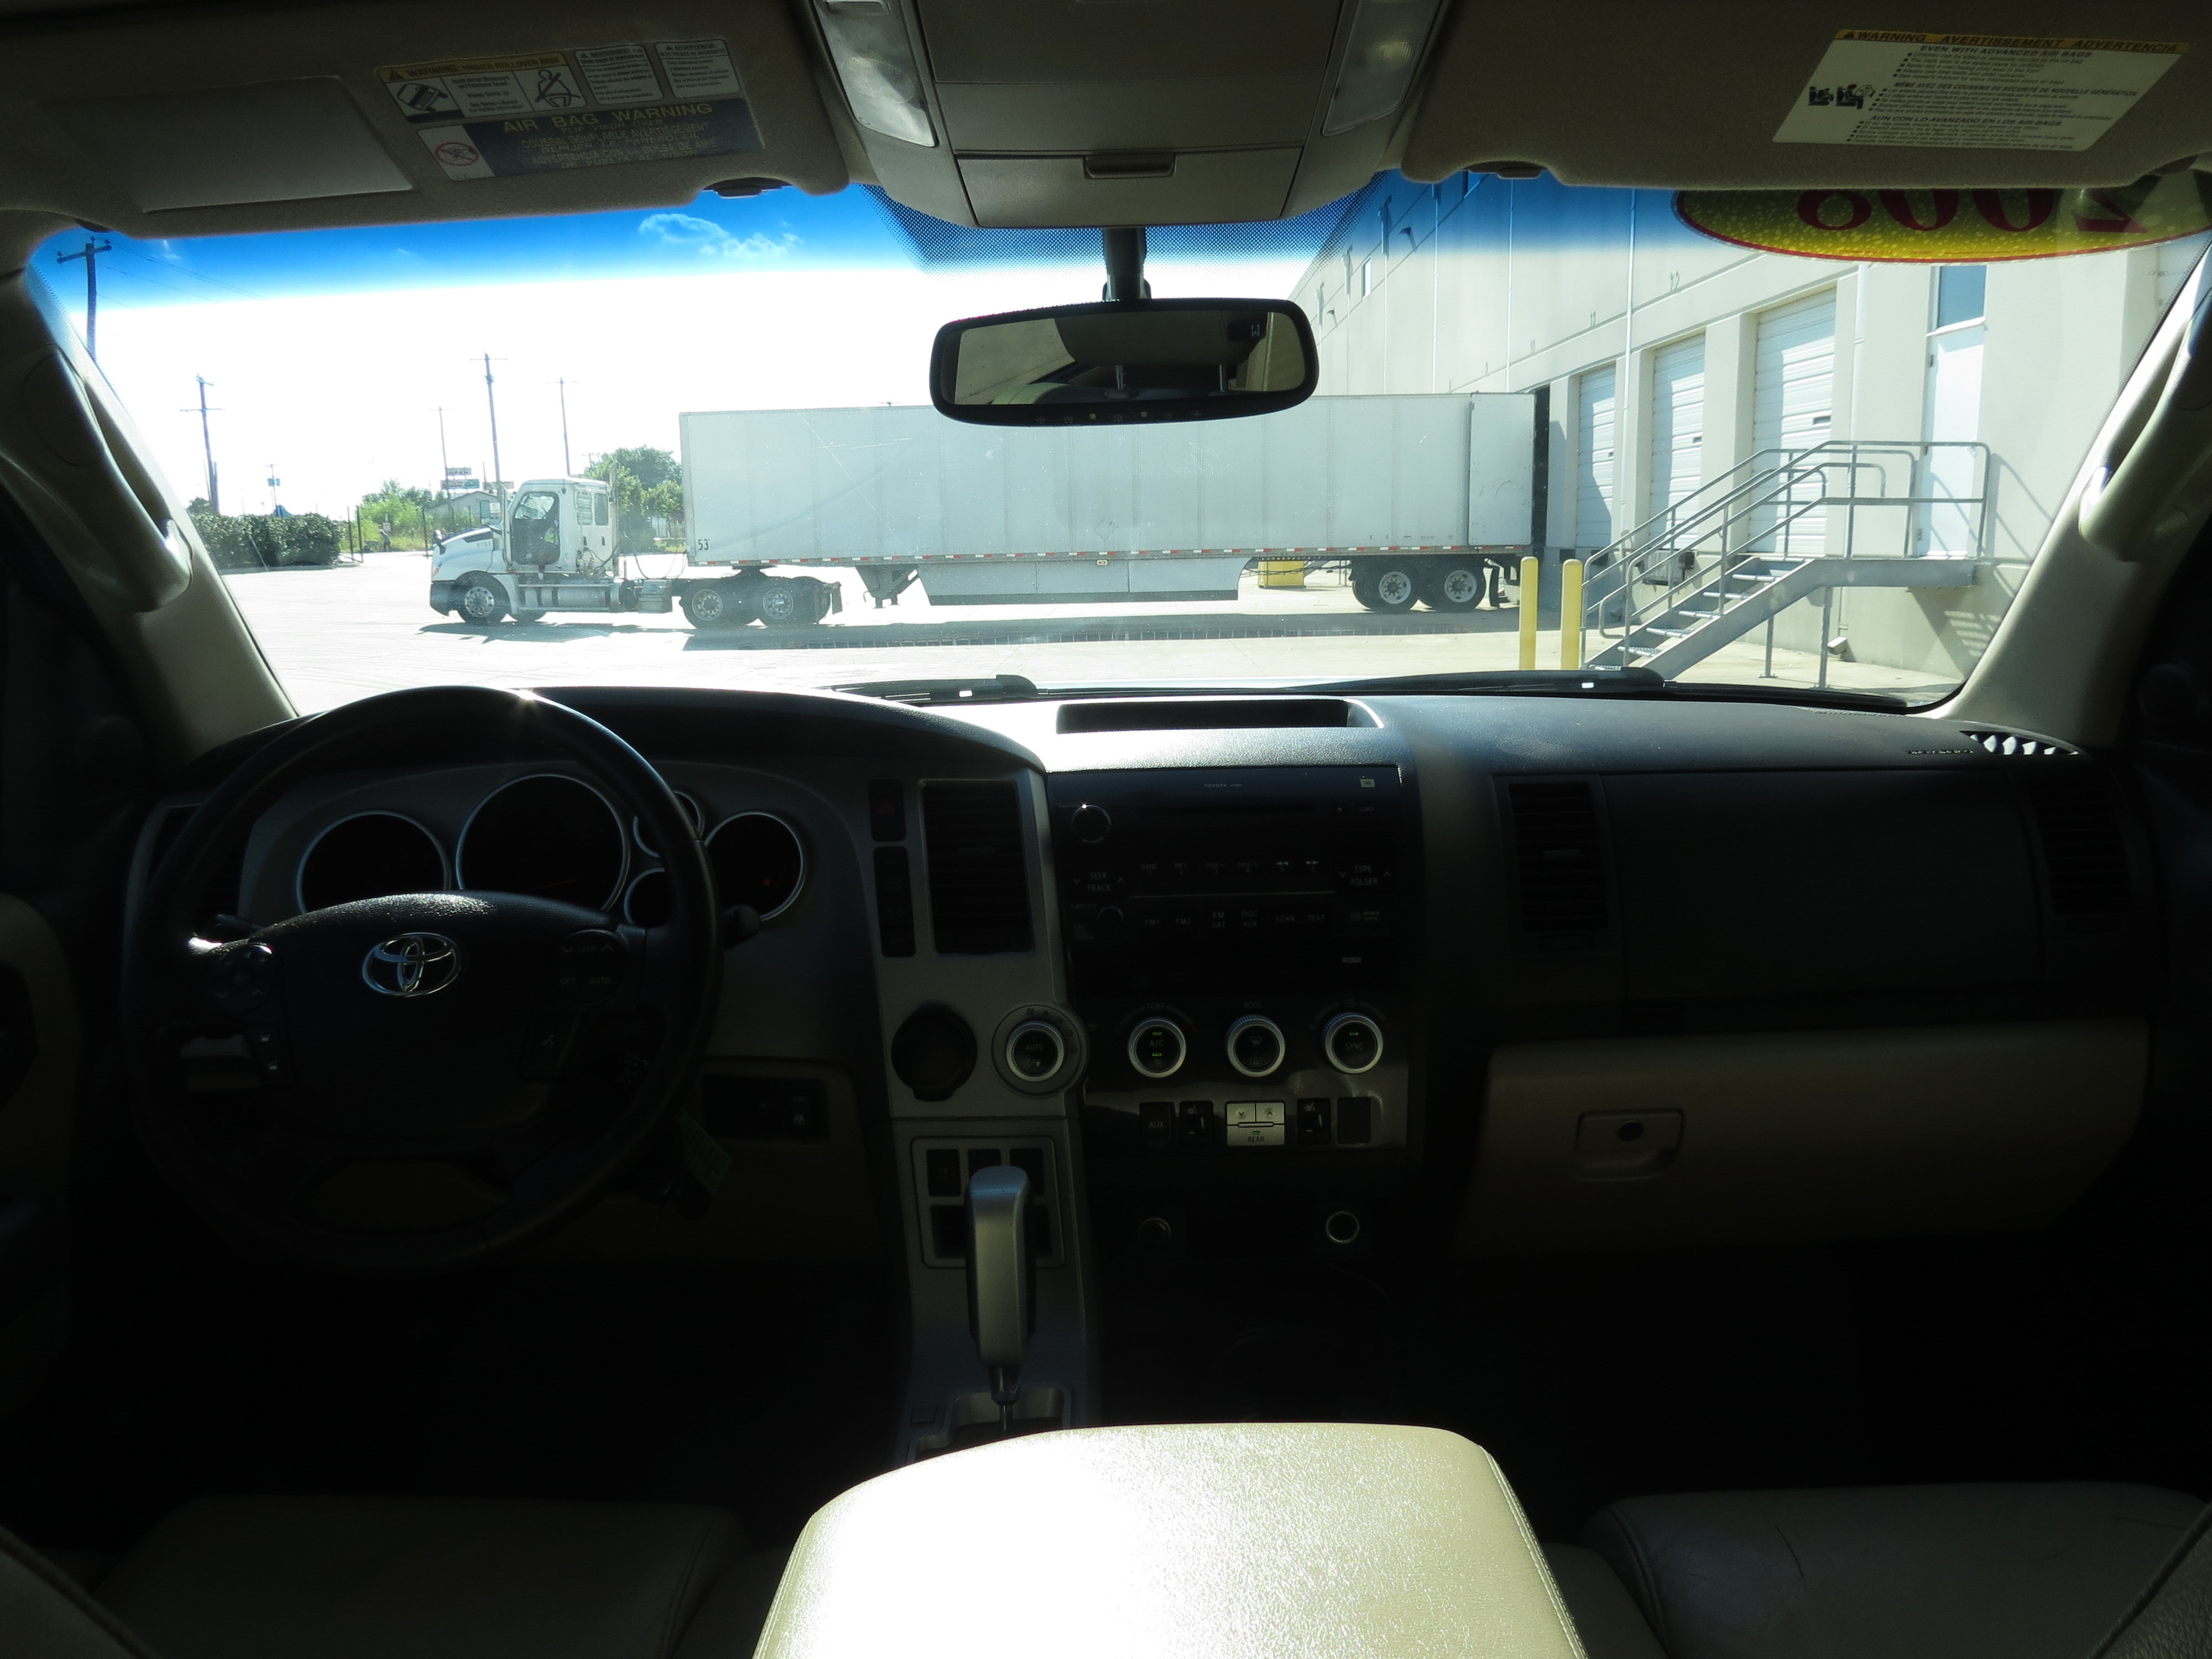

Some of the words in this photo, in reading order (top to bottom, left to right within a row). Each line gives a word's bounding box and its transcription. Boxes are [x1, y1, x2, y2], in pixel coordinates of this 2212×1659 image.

[1857, 32, 1927, 43] WARNING
[1939, 35, 2064, 48] AVERTISSEMENT
[2072, 40, 2178, 53] ADVERTENCIA
[540, 56, 560, 65] RISK
[504, 119, 539, 133] AIR
[552, 113, 599, 128] BAG
[611, 103, 713, 122] WARNING
[1354, 865, 1373, 873] TYPE
[1350, 878, 1379, 886] FOLDER
[1274, 915, 1296, 923] SCAN
[1306, 914, 1326, 922] TEXT
[560, 977, 576, 985] OFF
[589, 977, 612, 985] AUTO
[1149, 1039, 1165, 1047] A/C
[1344, 1042, 1364, 1051] SYNC
[1026, 1058, 1042, 1067] OFF
